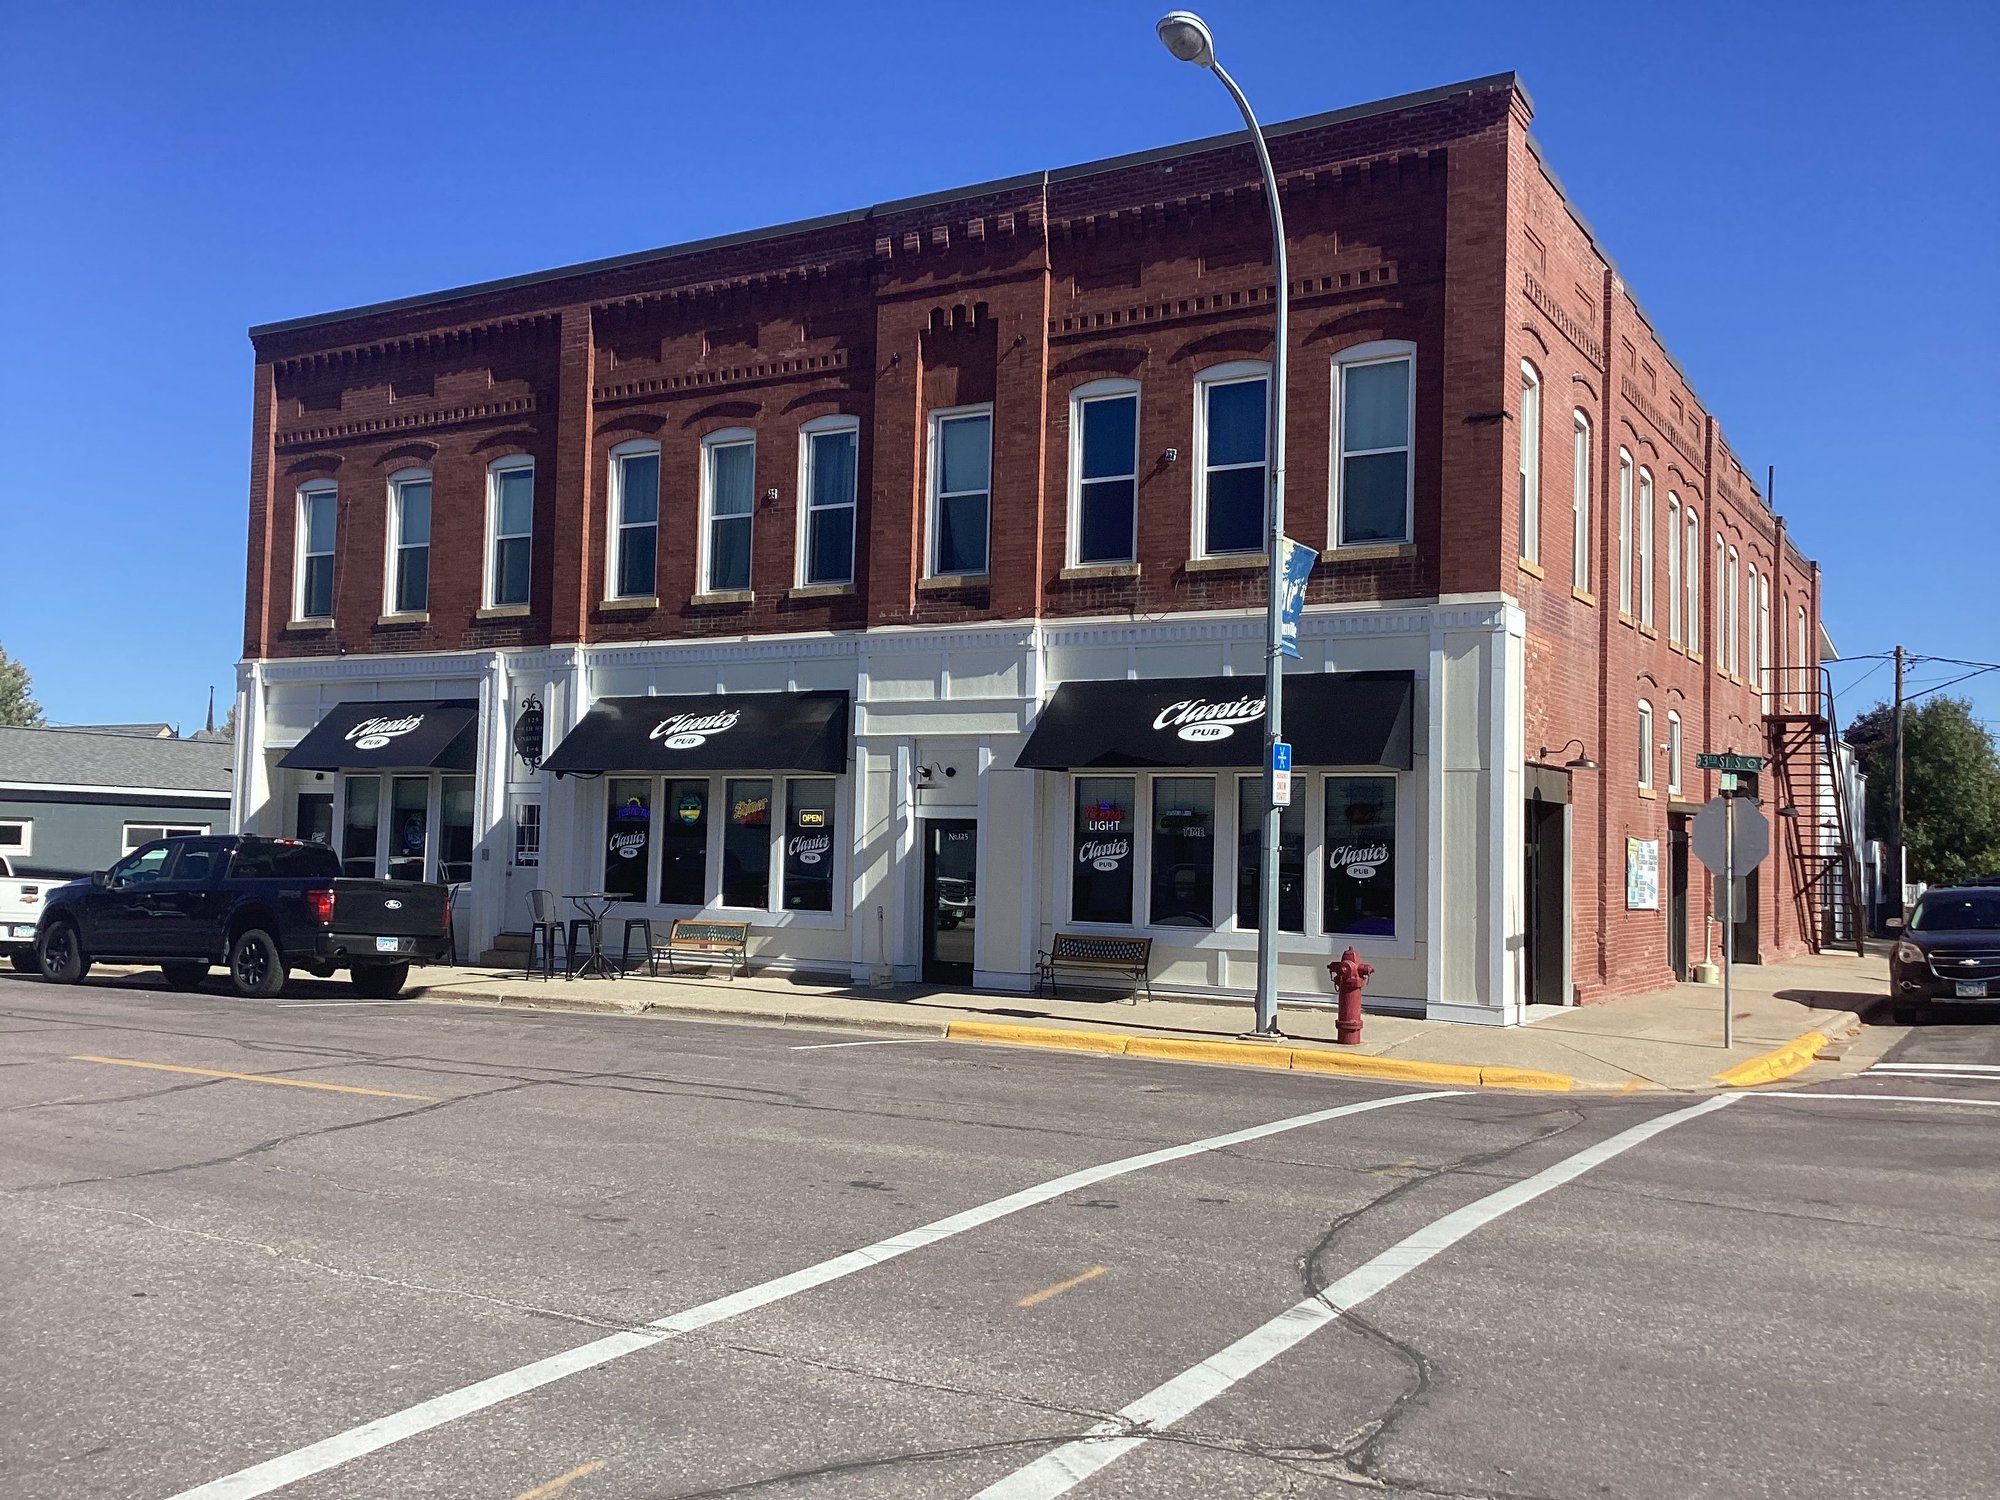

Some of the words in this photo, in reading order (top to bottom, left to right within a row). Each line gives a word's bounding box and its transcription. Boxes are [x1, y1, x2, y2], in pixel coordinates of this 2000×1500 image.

[1191, 728, 1221, 736] PUB
[673, 737, 696, 745] PUB
[802, 814, 822, 822] OPEN
[1089, 820, 1120, 831] LIGHT
